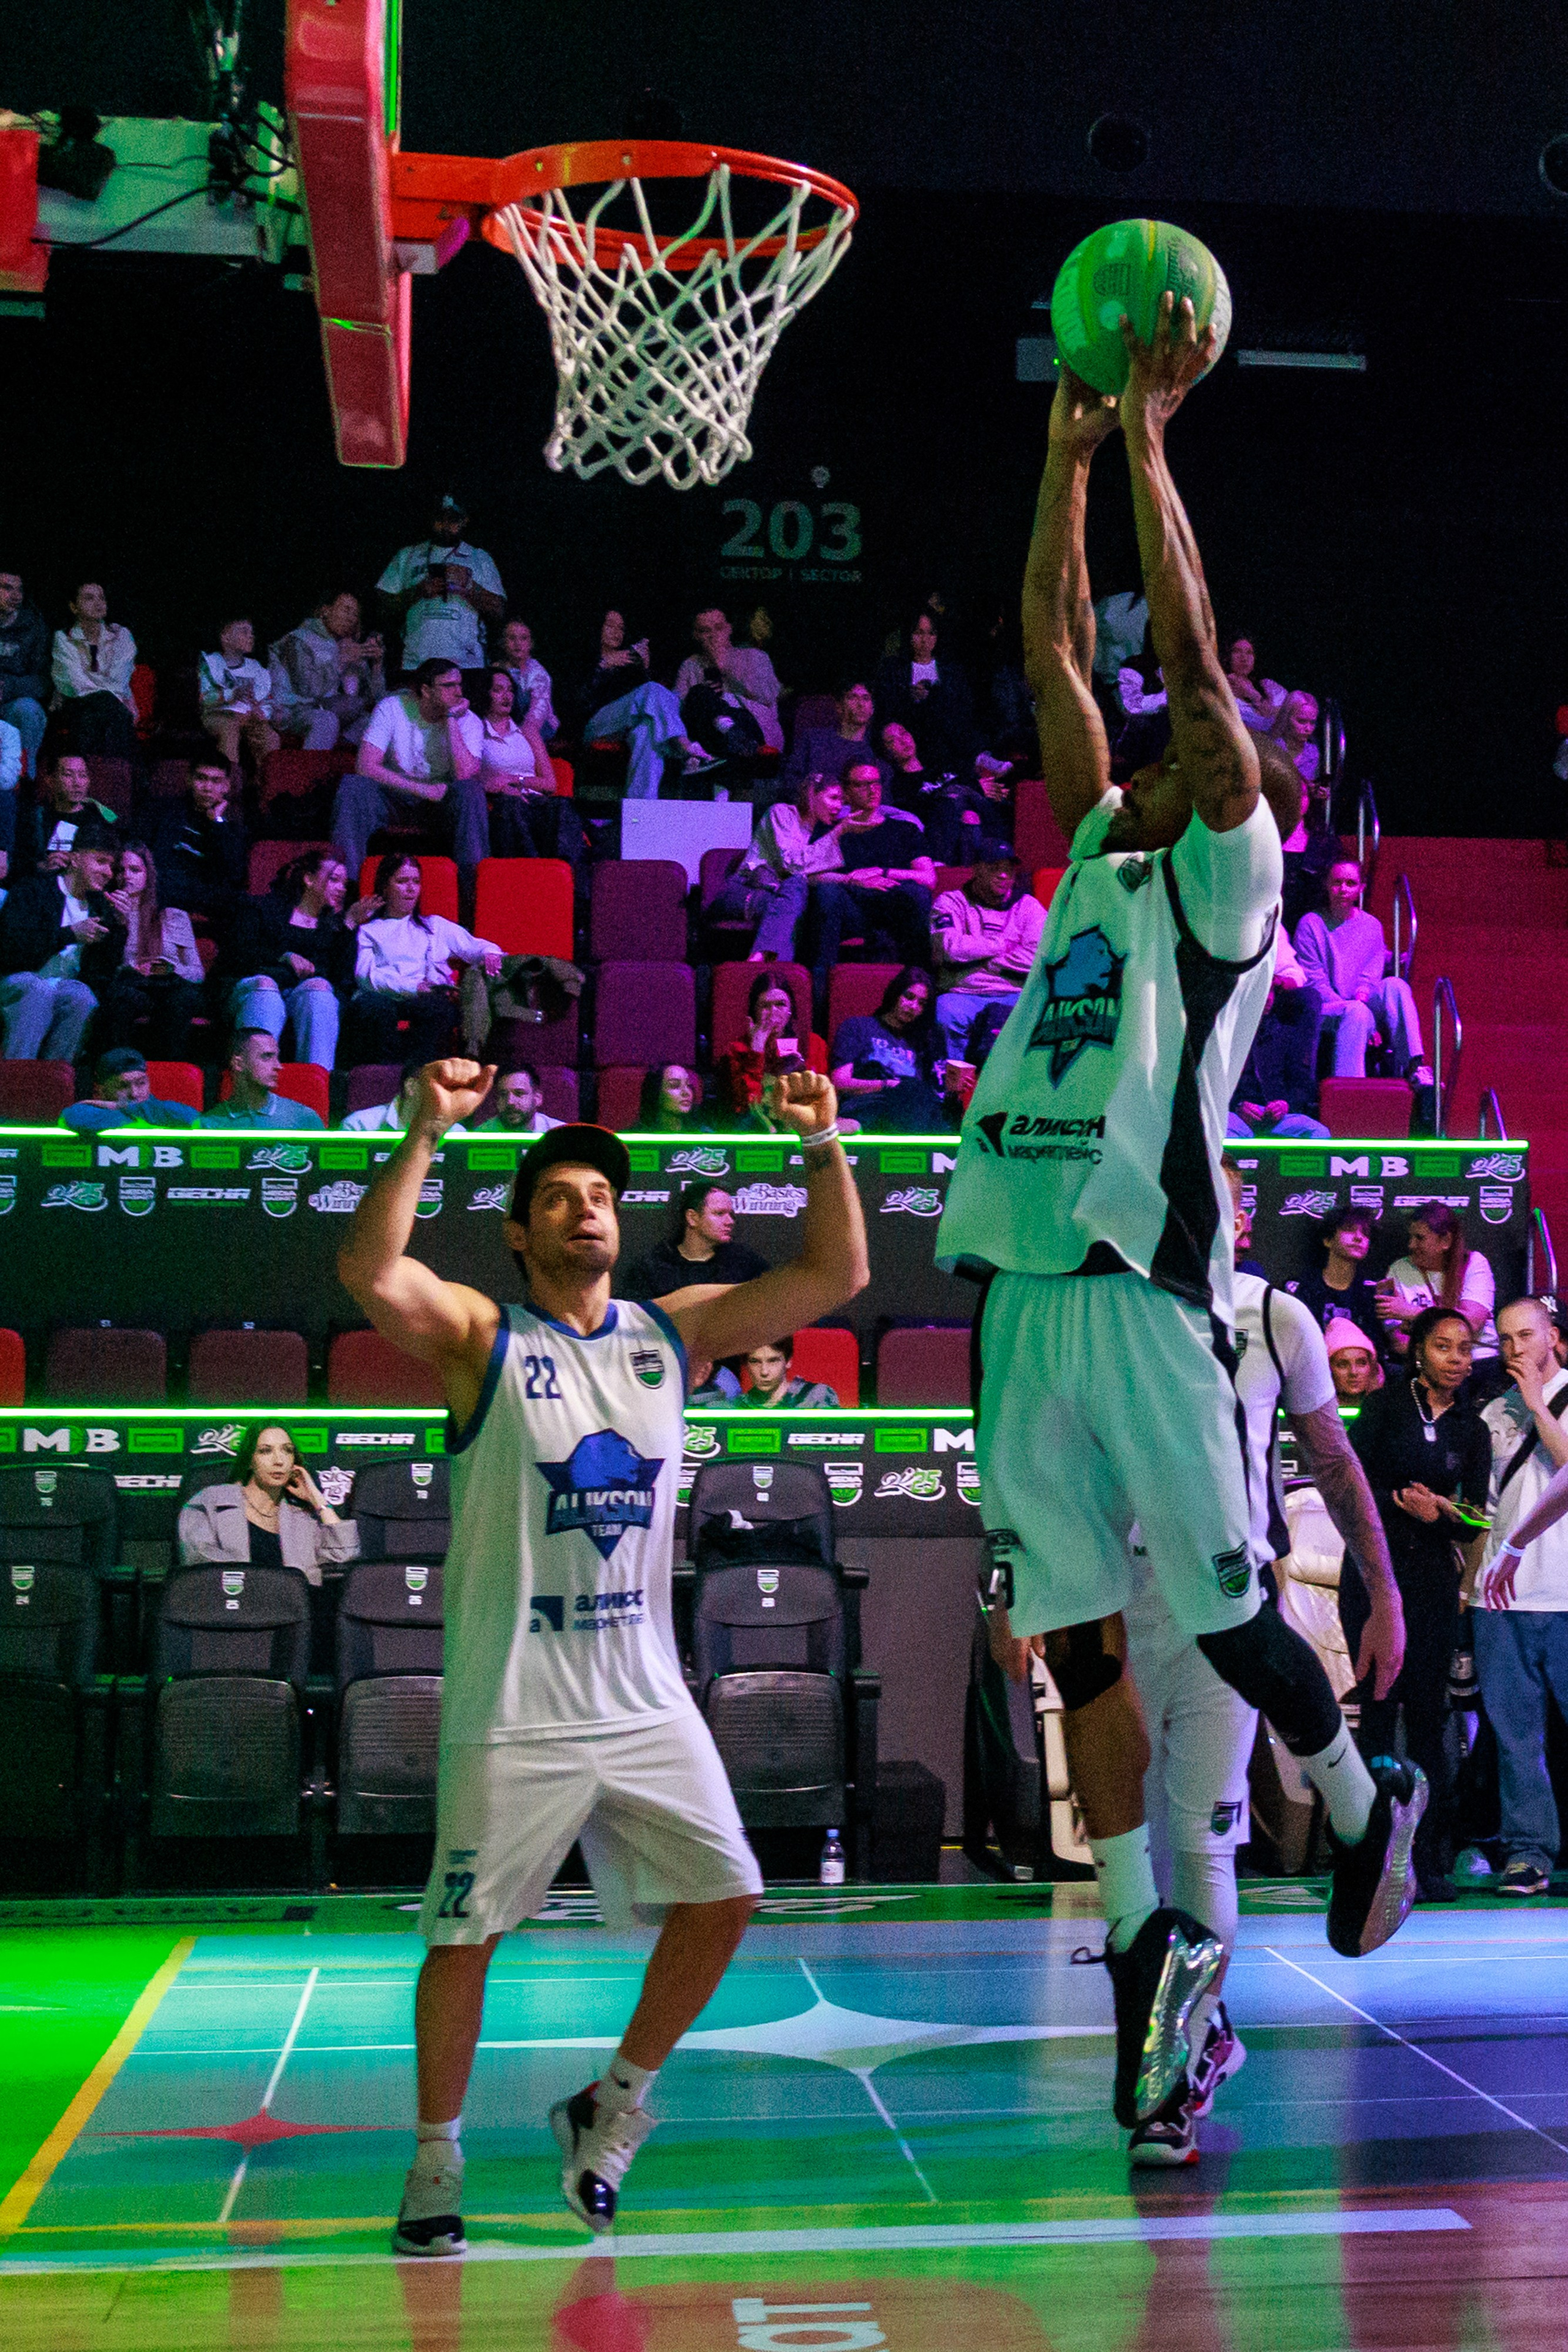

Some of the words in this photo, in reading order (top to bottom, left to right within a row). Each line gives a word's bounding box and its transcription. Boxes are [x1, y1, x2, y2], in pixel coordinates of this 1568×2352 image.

[721, 497, 862, 560] 203
[524, 1355, 561, 1400] 22
[438, 1871, 475, 1918] 22
